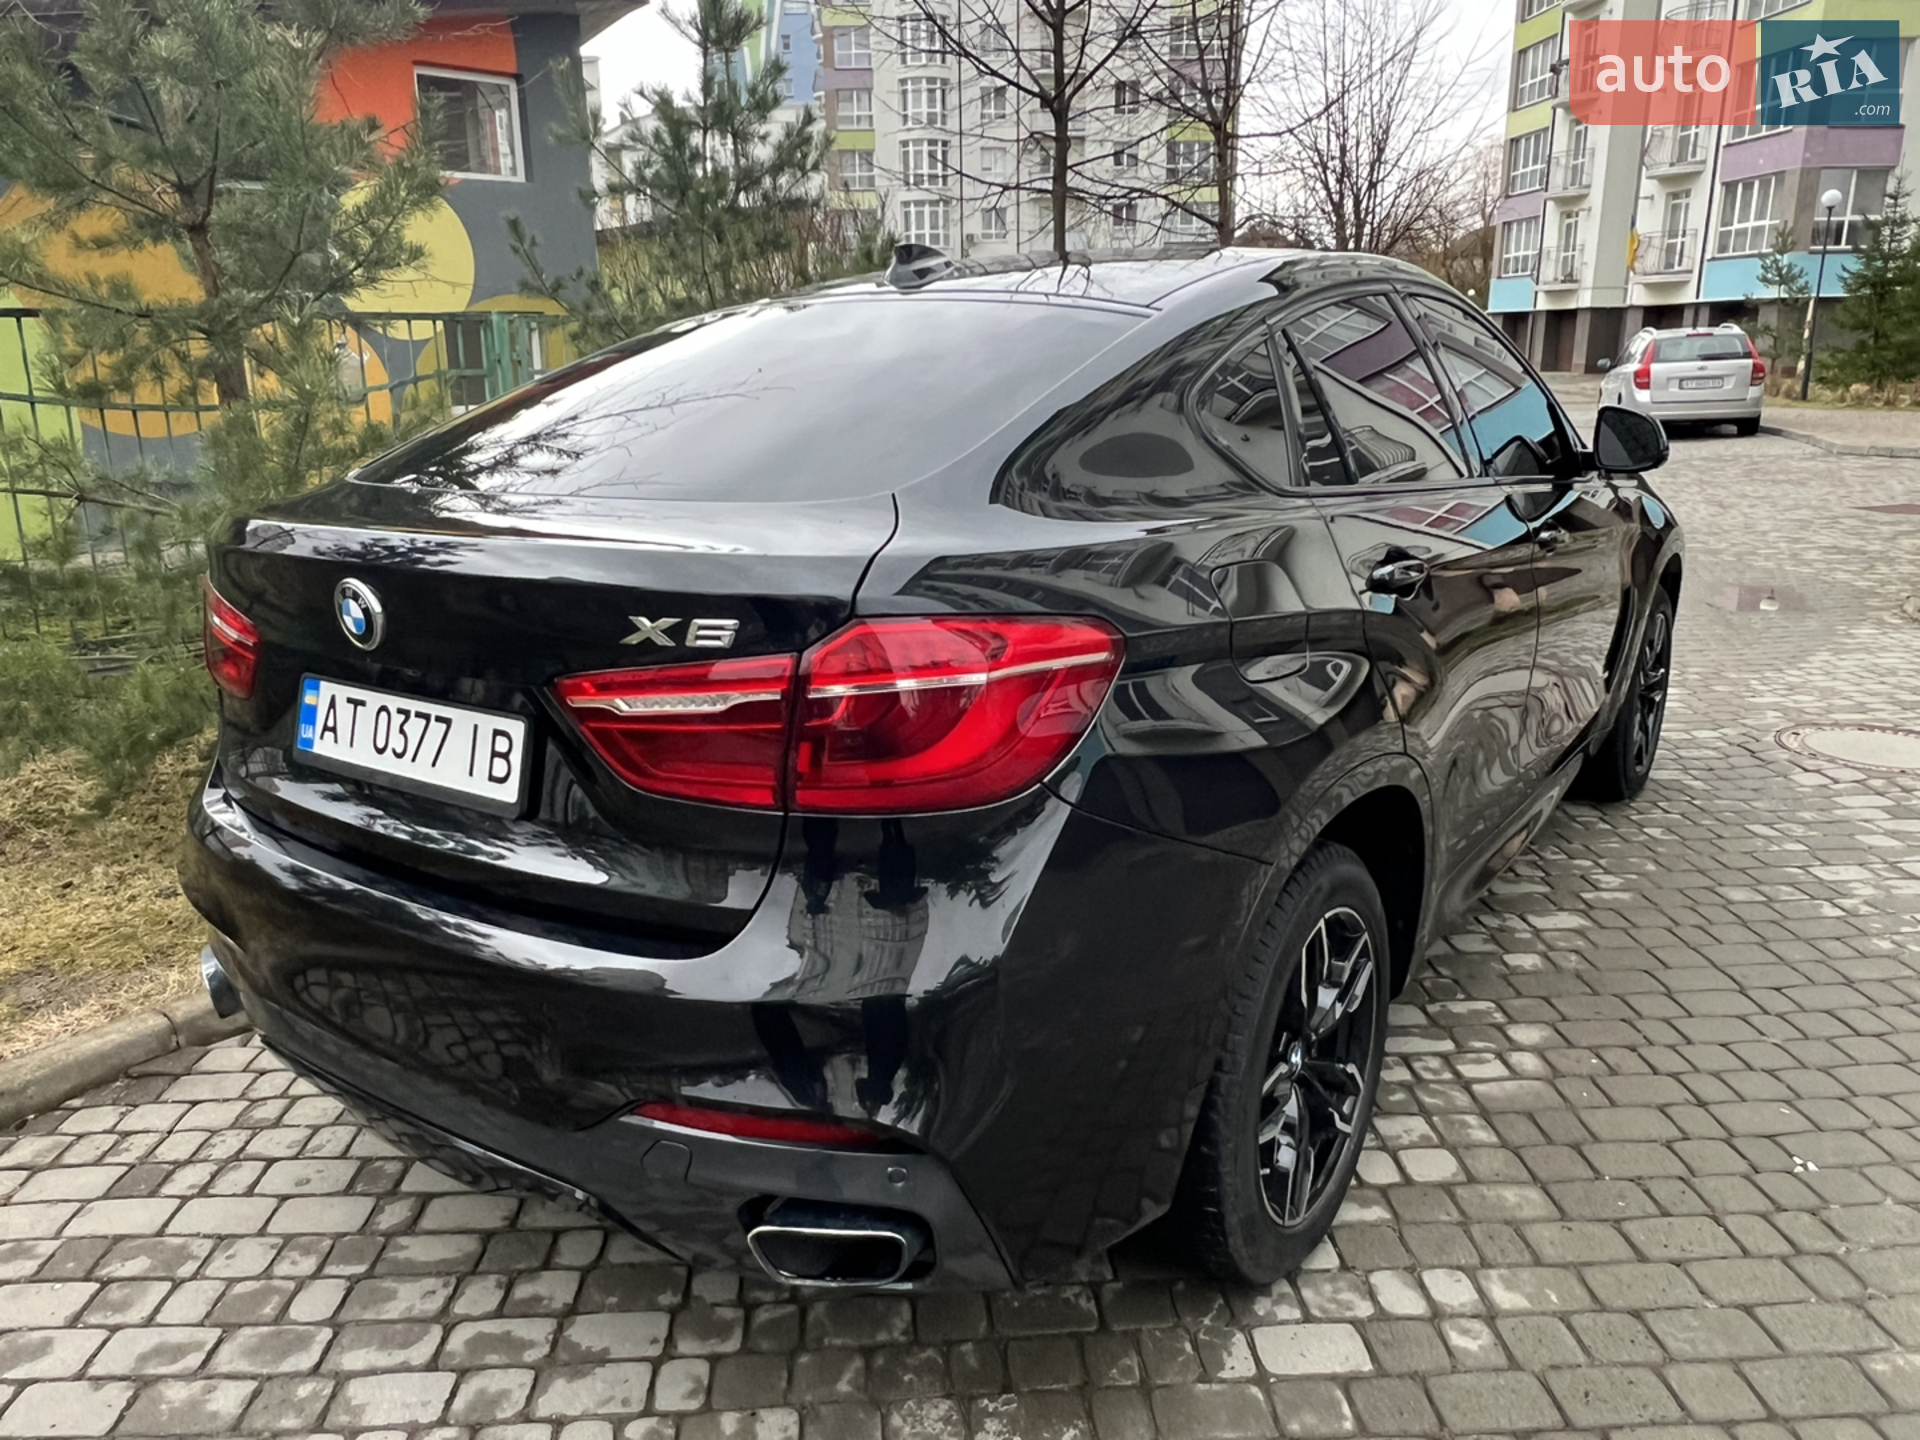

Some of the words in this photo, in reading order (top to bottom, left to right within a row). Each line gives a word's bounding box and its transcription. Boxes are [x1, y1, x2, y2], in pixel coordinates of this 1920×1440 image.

[619, 615, 740, 649] X6
[301, 723, 314, 740] UA
[319, 693, 367, 749] AT
[372, 704, 453, 769] 0377
[468, 723, 514, 785] IB
